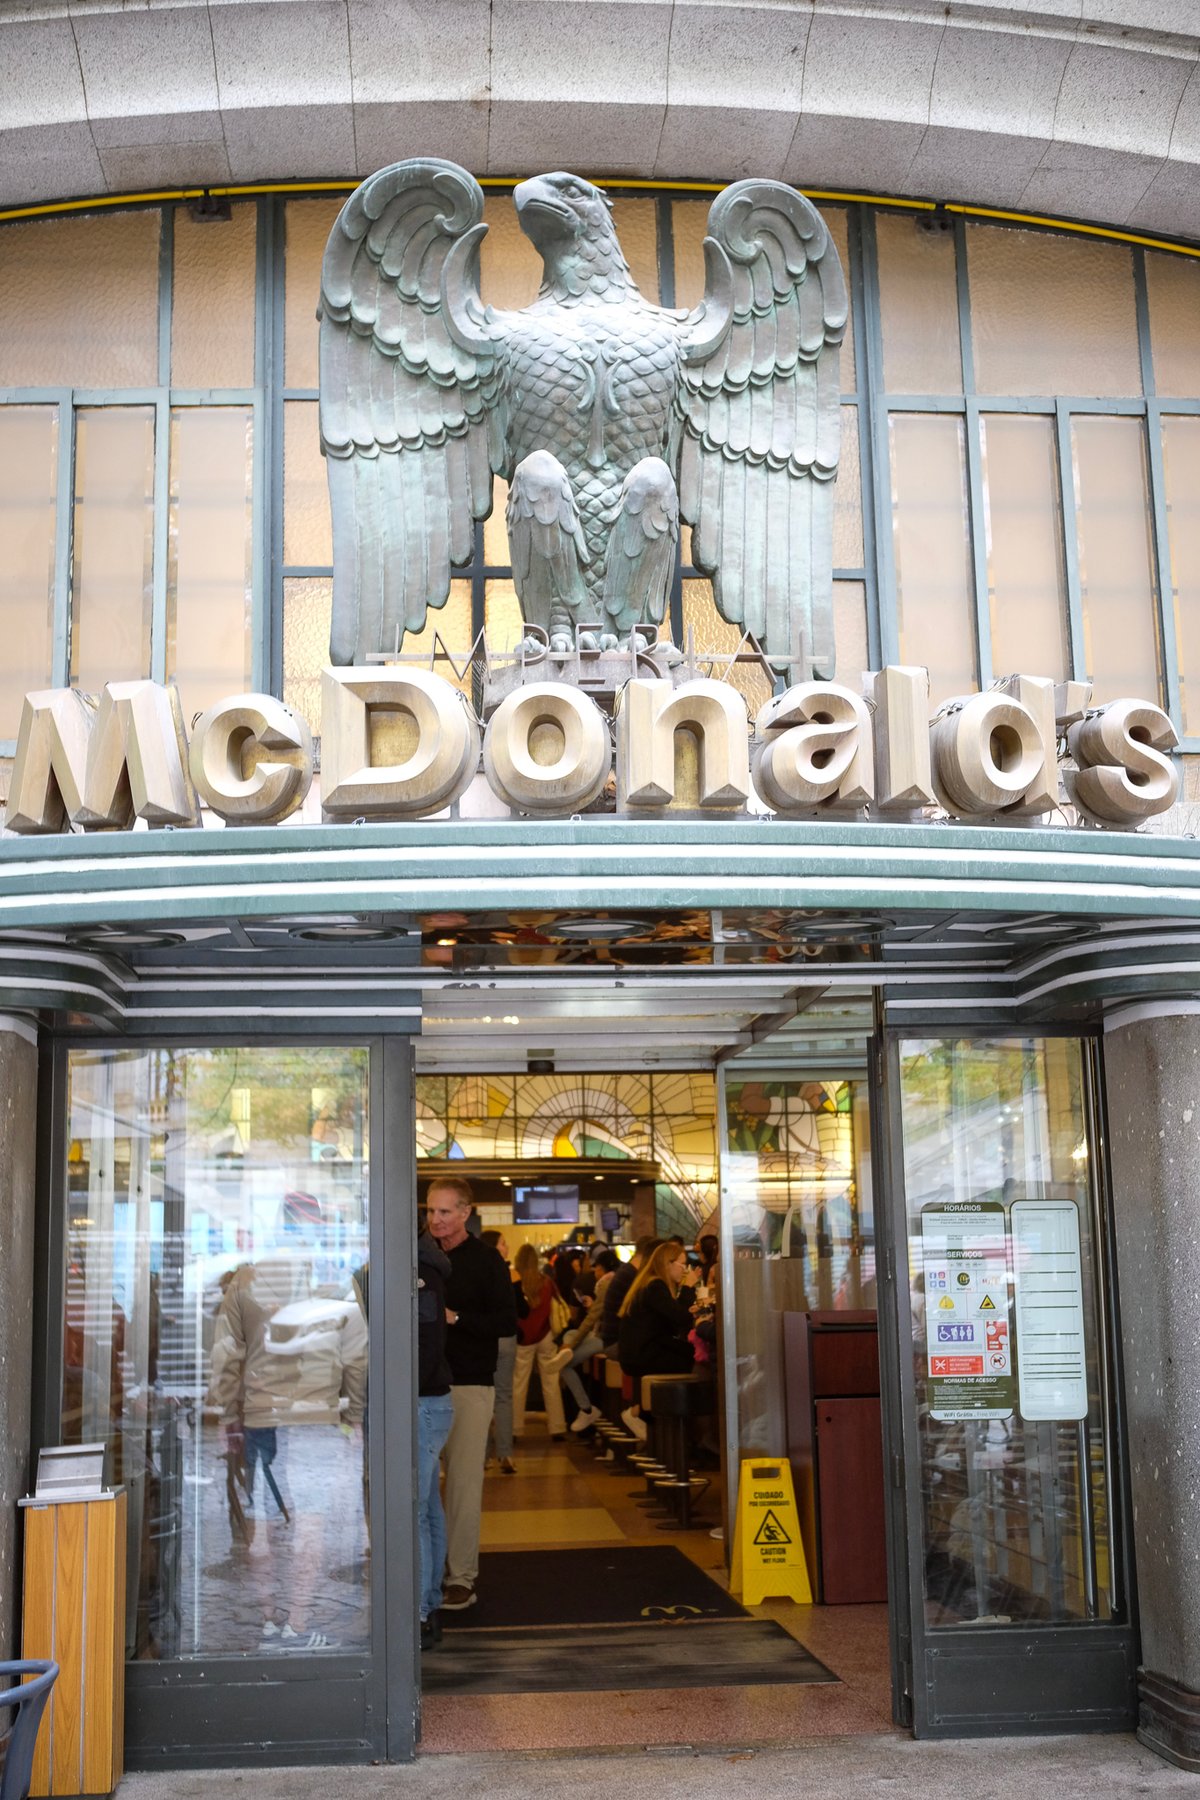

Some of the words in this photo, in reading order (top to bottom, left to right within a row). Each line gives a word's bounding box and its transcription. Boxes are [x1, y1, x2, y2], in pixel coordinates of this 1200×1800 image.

[3, 665, 1181, 834] McDonald's
[943, 1203, 982, 1212] HORÁRIOS
[946, 1250, 984, 1259] SERVIÇOS
[753, 1491, 784, 1499] CUIDADO
[760, 1547, 786, 1555] CAUTION
